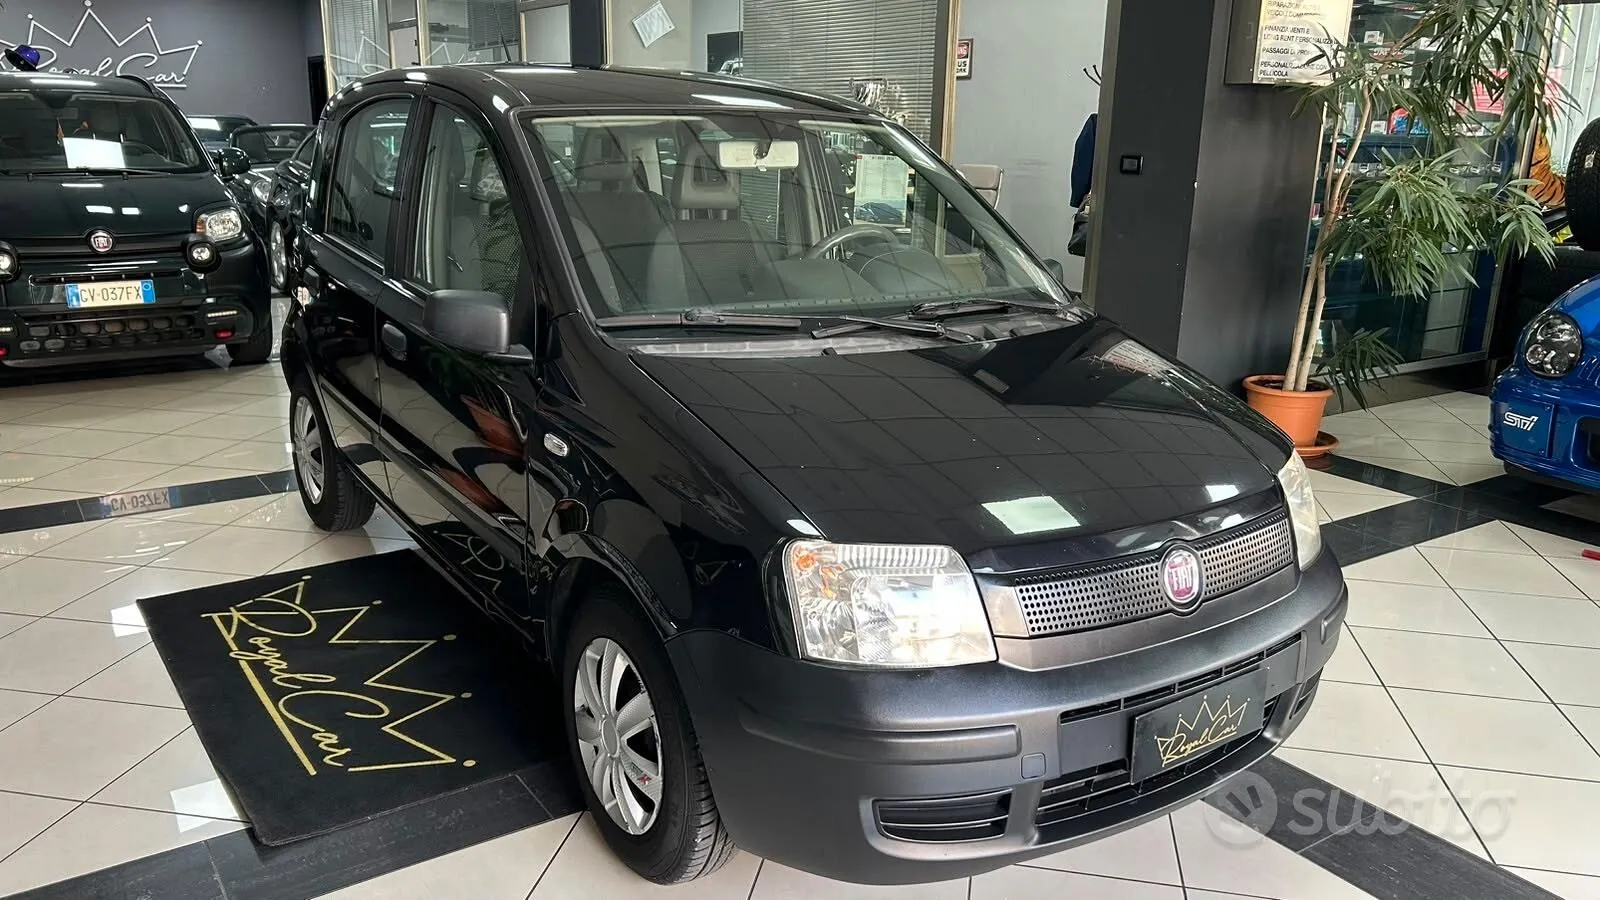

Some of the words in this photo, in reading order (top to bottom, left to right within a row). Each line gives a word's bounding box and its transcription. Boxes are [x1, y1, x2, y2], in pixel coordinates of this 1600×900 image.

[116, 53, 185, 83] Car
[1262, 46, 1289, 55] PASSAGGI
[201, 598, 337, 689] Royal
[278, 690, 390, 767] Car
[1161, 728, 1209, 767] Royal
[1208, 715, 1238, 742] Car
